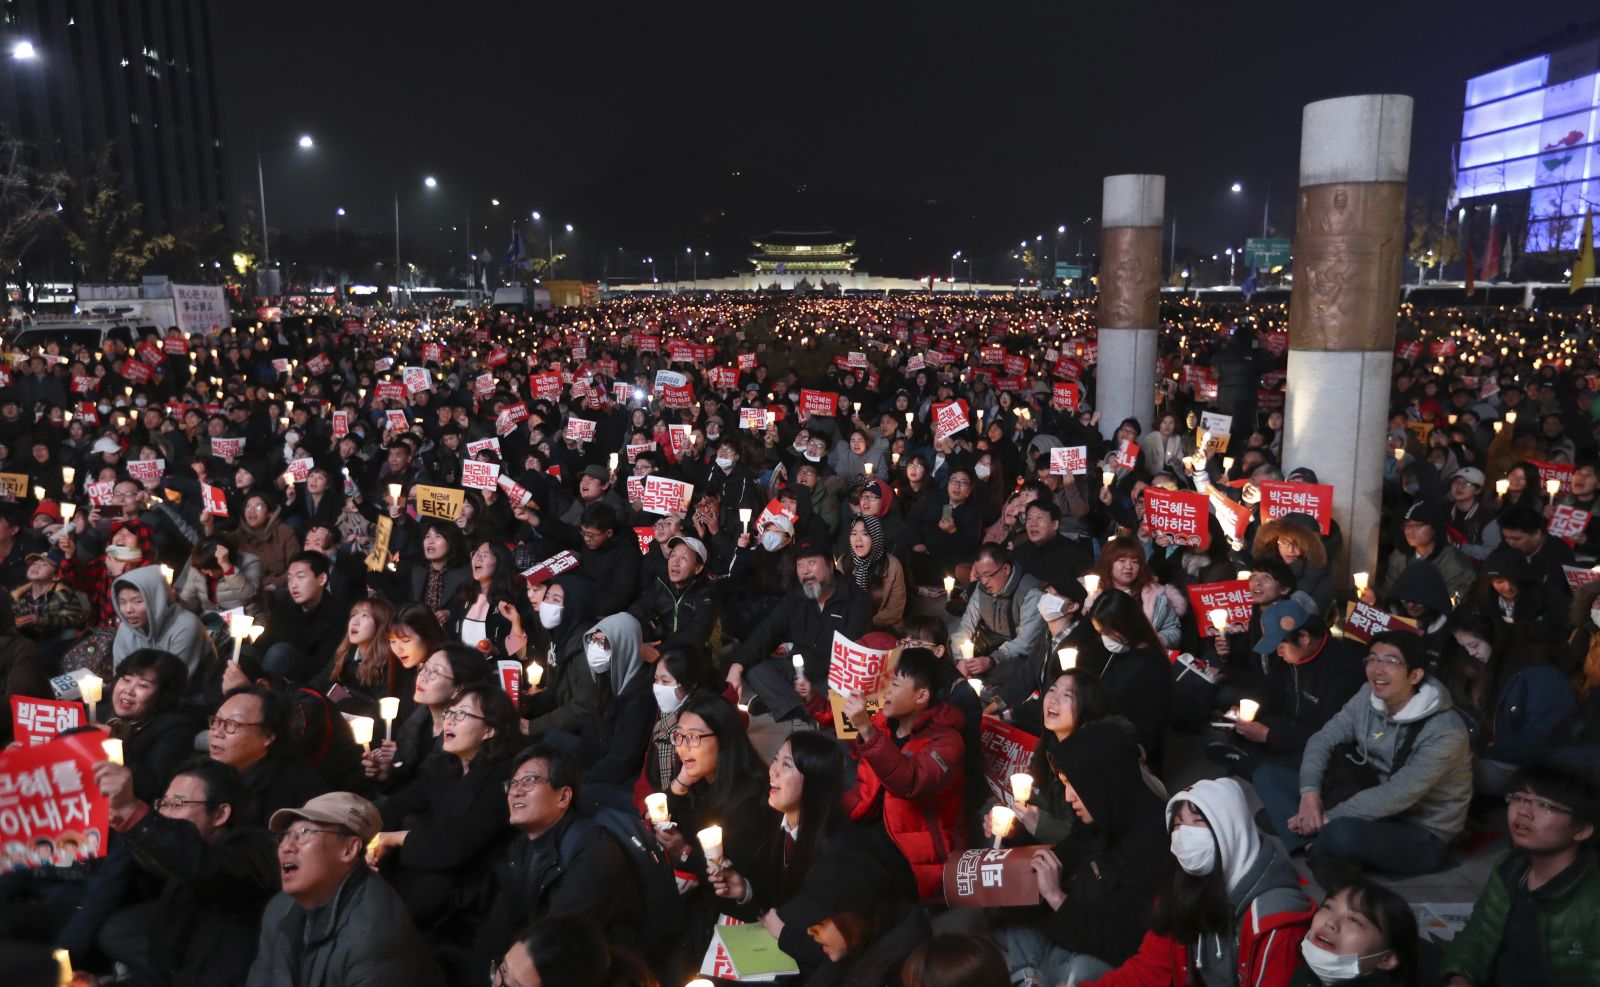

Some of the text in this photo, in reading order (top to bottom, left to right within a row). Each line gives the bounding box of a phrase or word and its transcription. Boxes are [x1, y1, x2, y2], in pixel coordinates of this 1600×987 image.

[805, 402, 831, 411] 하야하라
[806, 394, 832, 405] 박근혜는
[740, 408, 765, 419] 박근혜
[938, 405, 956, 423] 근혜
[129, 463, 157, 473] 박근혜
[464, 463, 491, 475] 박근혜
[1050, 458, 1087, 473] 즉퇴진
[463, 474, 497, 487] 즉각퇴진
[627, 479, 644, 491] 박근
[647, 480, 685, 497] 박근혜
[430, 491, 450, 501] 박근혜
[1269, 490, 1320, 508] 박근혜는
[421, 498, 457, 520] 퇴진!
[1150, 496, 1196, 518] 박근혜는
[1150, 512, 1196, 534] 하야하라
[1356, 602, 1391, 626] 박근혜
[833, 641, 888, 676] 박근혜
[828, 664, 882, 698] 즉각퇴
[17, 702, 79, 734] 박근혜
[982, 729, 1018, 760] 박근혜
[0, 759, 84, 806] 근혜를
[0, 793, 92, 838] 아내자
